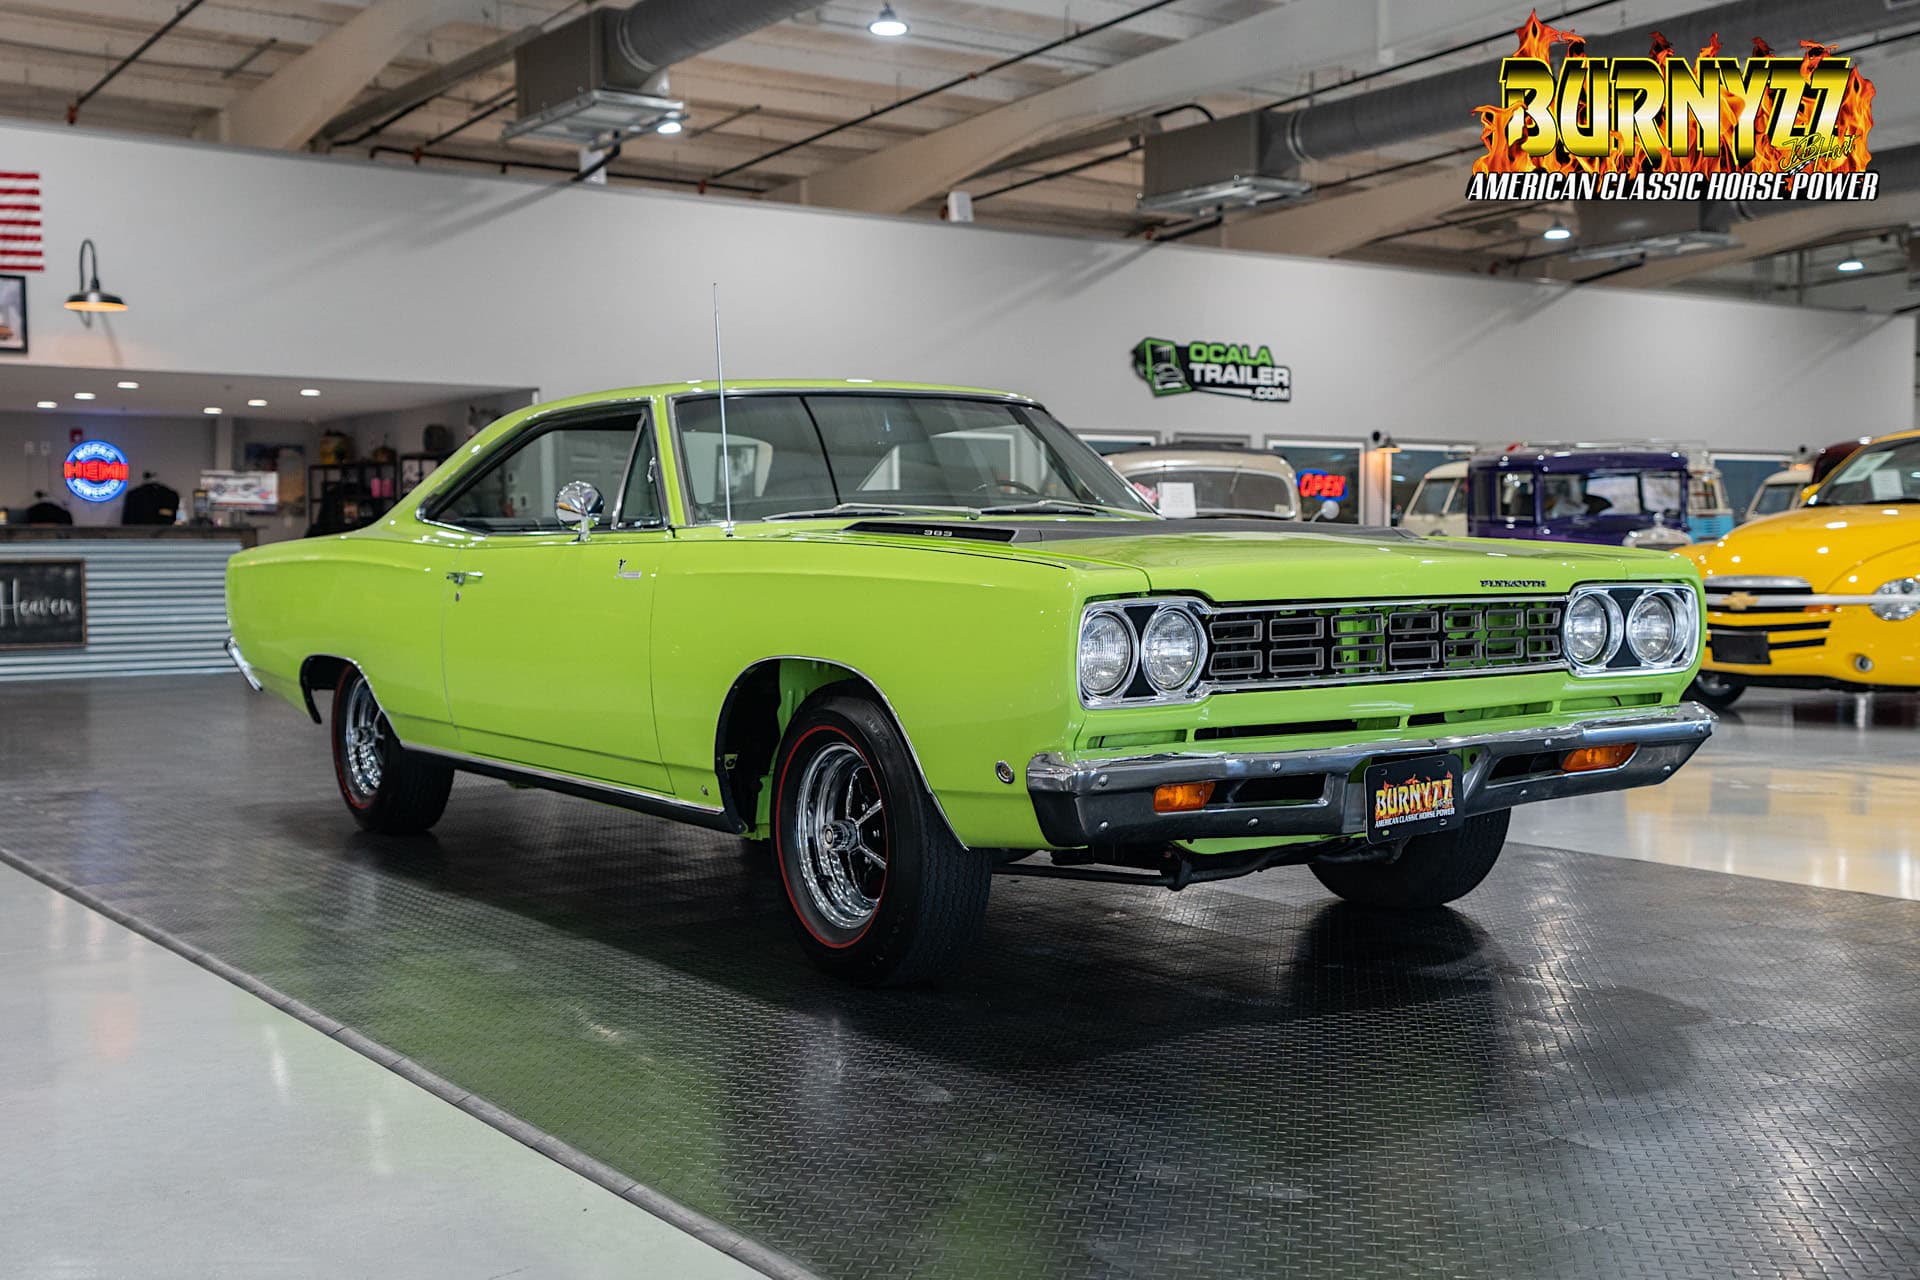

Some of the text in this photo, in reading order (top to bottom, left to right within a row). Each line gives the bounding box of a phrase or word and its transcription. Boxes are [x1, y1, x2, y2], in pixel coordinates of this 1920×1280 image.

[1189, 342, 1273, 367] OCALA
[1189, 363, 1289, 387] TRAILER
[1252, 386, 1289, 400] .COM
[64, 461, 128, 481] HEMI
[1300, 473, 1346, 497] OPEN
[0, 578, 77, 627] Heaven
[1376, 779, 1451, 817] BURNYZZ
[1436, 807, 1455, 818] POWER
